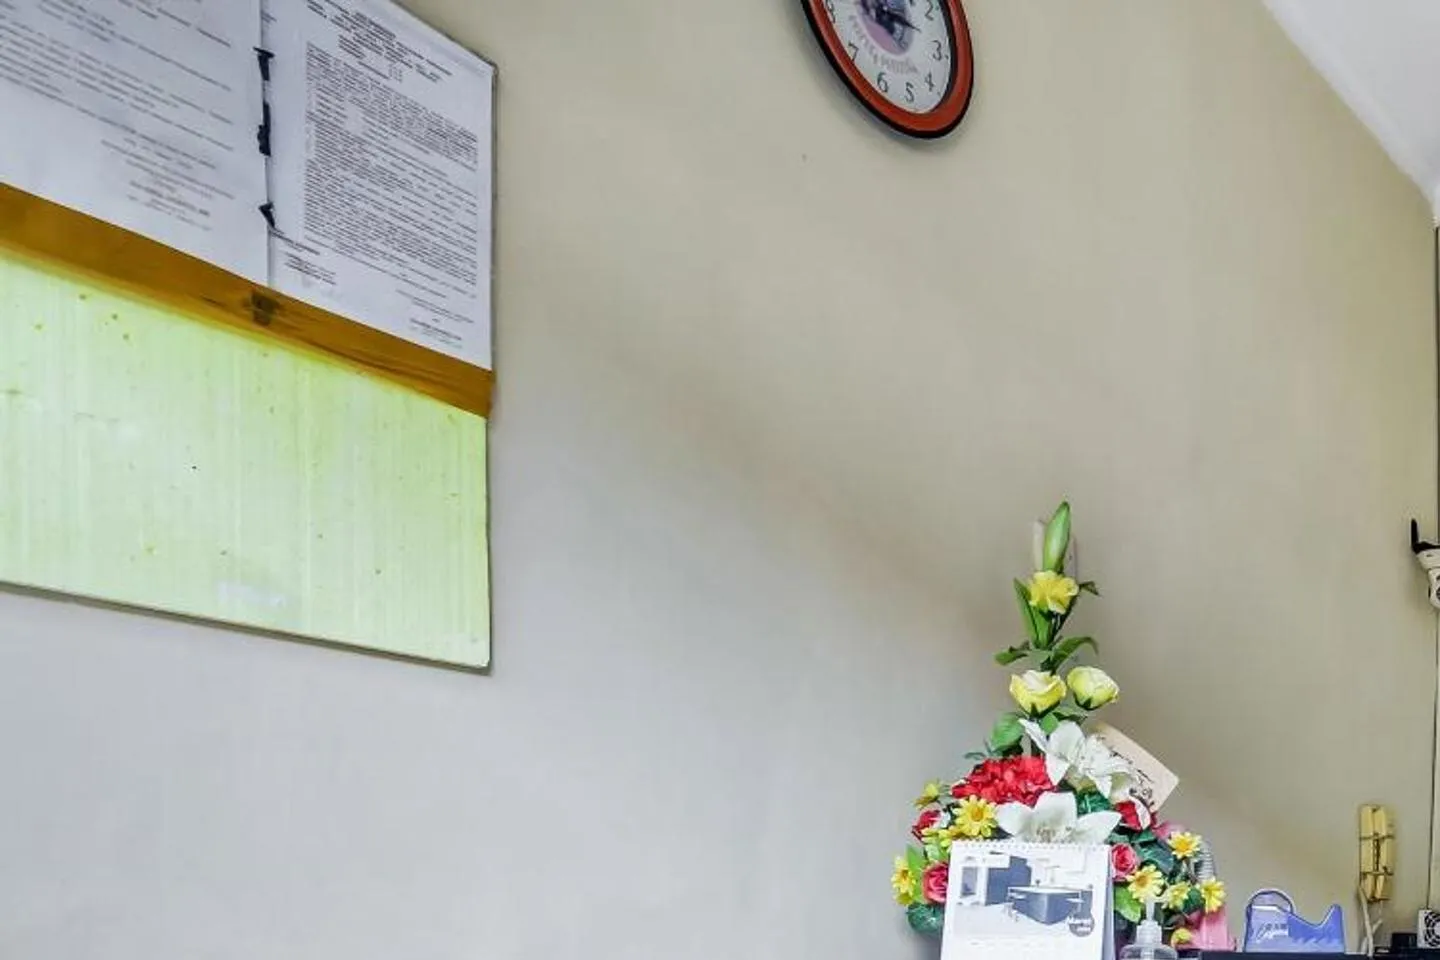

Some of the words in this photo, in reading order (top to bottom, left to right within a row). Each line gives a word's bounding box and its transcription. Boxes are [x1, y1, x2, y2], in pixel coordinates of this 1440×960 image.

[925, 3, 934, 21] 2
[848, 41, 859, 61] 7
[932, 39, 942, 62] 3
[877, 72, 889, 93] 6
[924, 71, 935, 92] 4
[905, 82, 915, 102] 5
